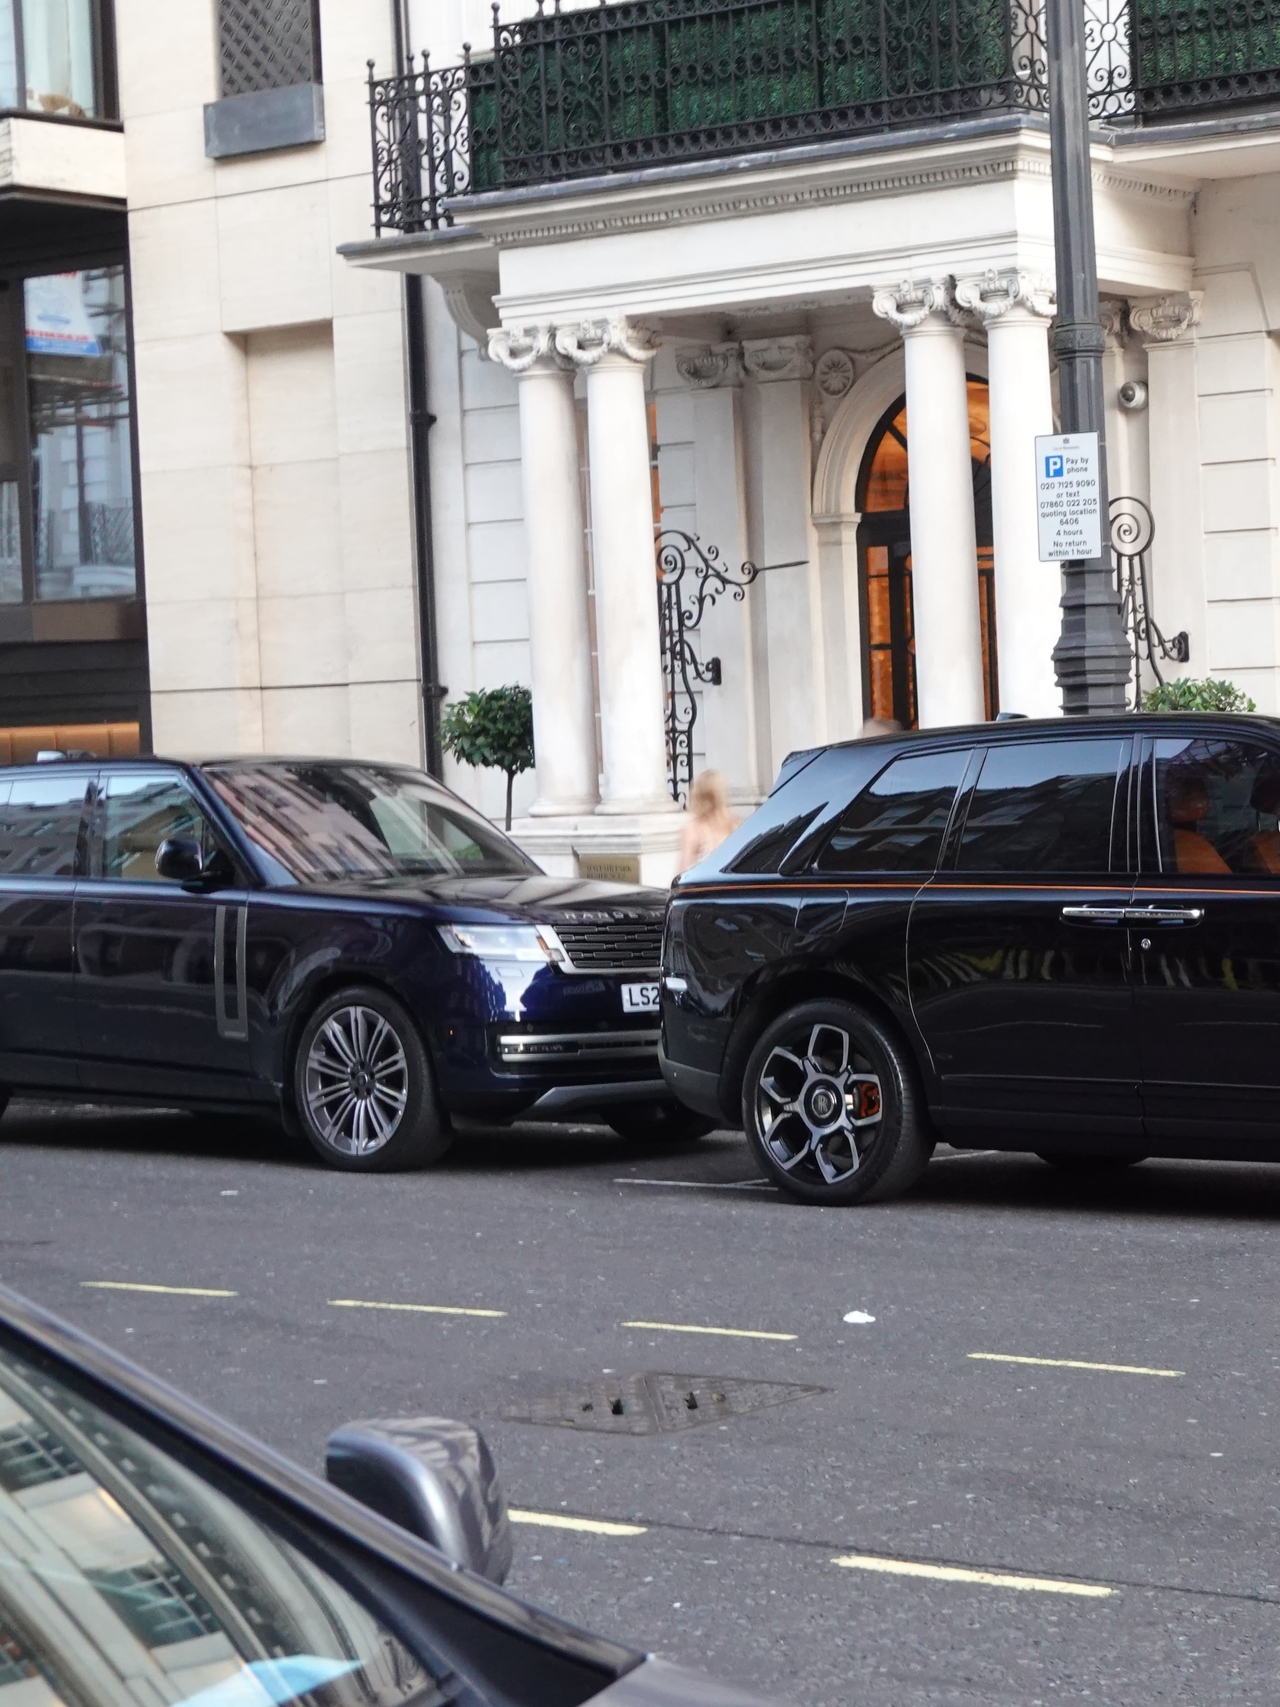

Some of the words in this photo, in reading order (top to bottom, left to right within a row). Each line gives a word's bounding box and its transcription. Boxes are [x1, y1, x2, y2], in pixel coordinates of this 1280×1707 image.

[1049, 457, 1061, 477] P
[1066, 457, 1078, 465] Pay
[1080, 456, 1089, 464] by
[1066, 466, 1088, 475] phone
[1040, 482, 1055, 490] 020
[1057, 481, 1074, 489] 7125
[1076, 479, 1096, 487] 9090
[1040, 501, 1064, 509] 07860
[1066, 499, 1080, 507] 022
[1083, 498, 1097, 506] 205
[1040, 510, 1067, 519] quoting
[1069, 507, 1097, 516] location
[1059, 517, 1079, 526] 6406
[1053, 540, 1063, 548] No
[1065, 539, 1087, 547] return
[1048, 548, 1069, 557] within
[1076, 546, 1093, 555] hour
[564, 911, 639, 920] RANGE
